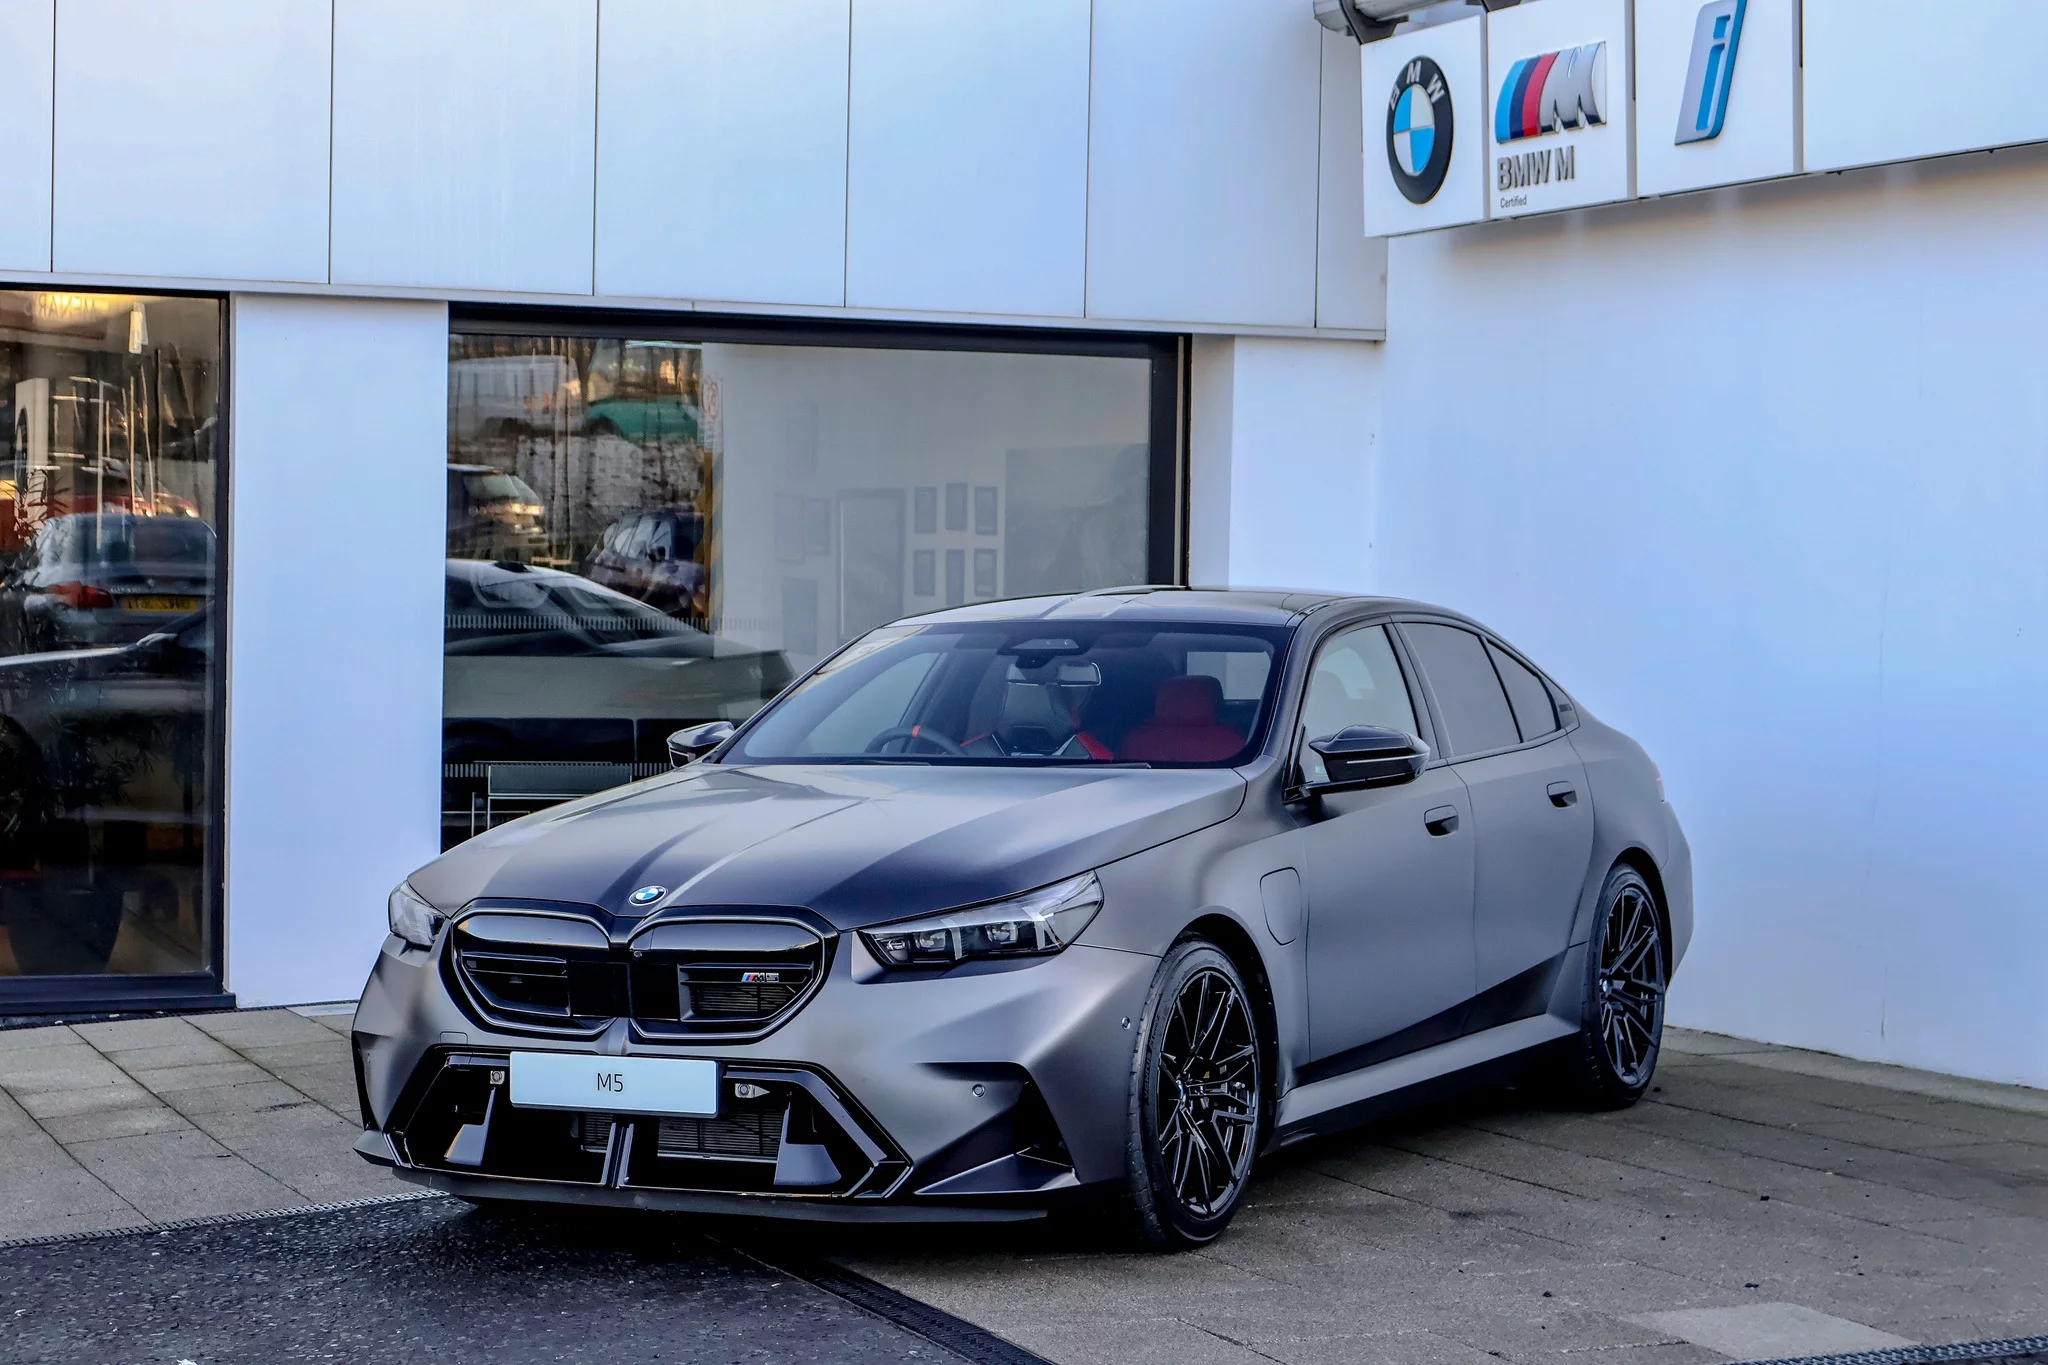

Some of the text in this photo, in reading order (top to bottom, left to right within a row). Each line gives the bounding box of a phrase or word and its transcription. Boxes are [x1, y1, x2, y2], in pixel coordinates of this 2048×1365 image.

[1389, 60, 1445, 111] BMW
[1497, 145, 1575, 191] BMW M
[1500, 194, 1527, 209] Certified
[753, 972, 780, 983] M5
[597, 1072, 624, 1093] M5
